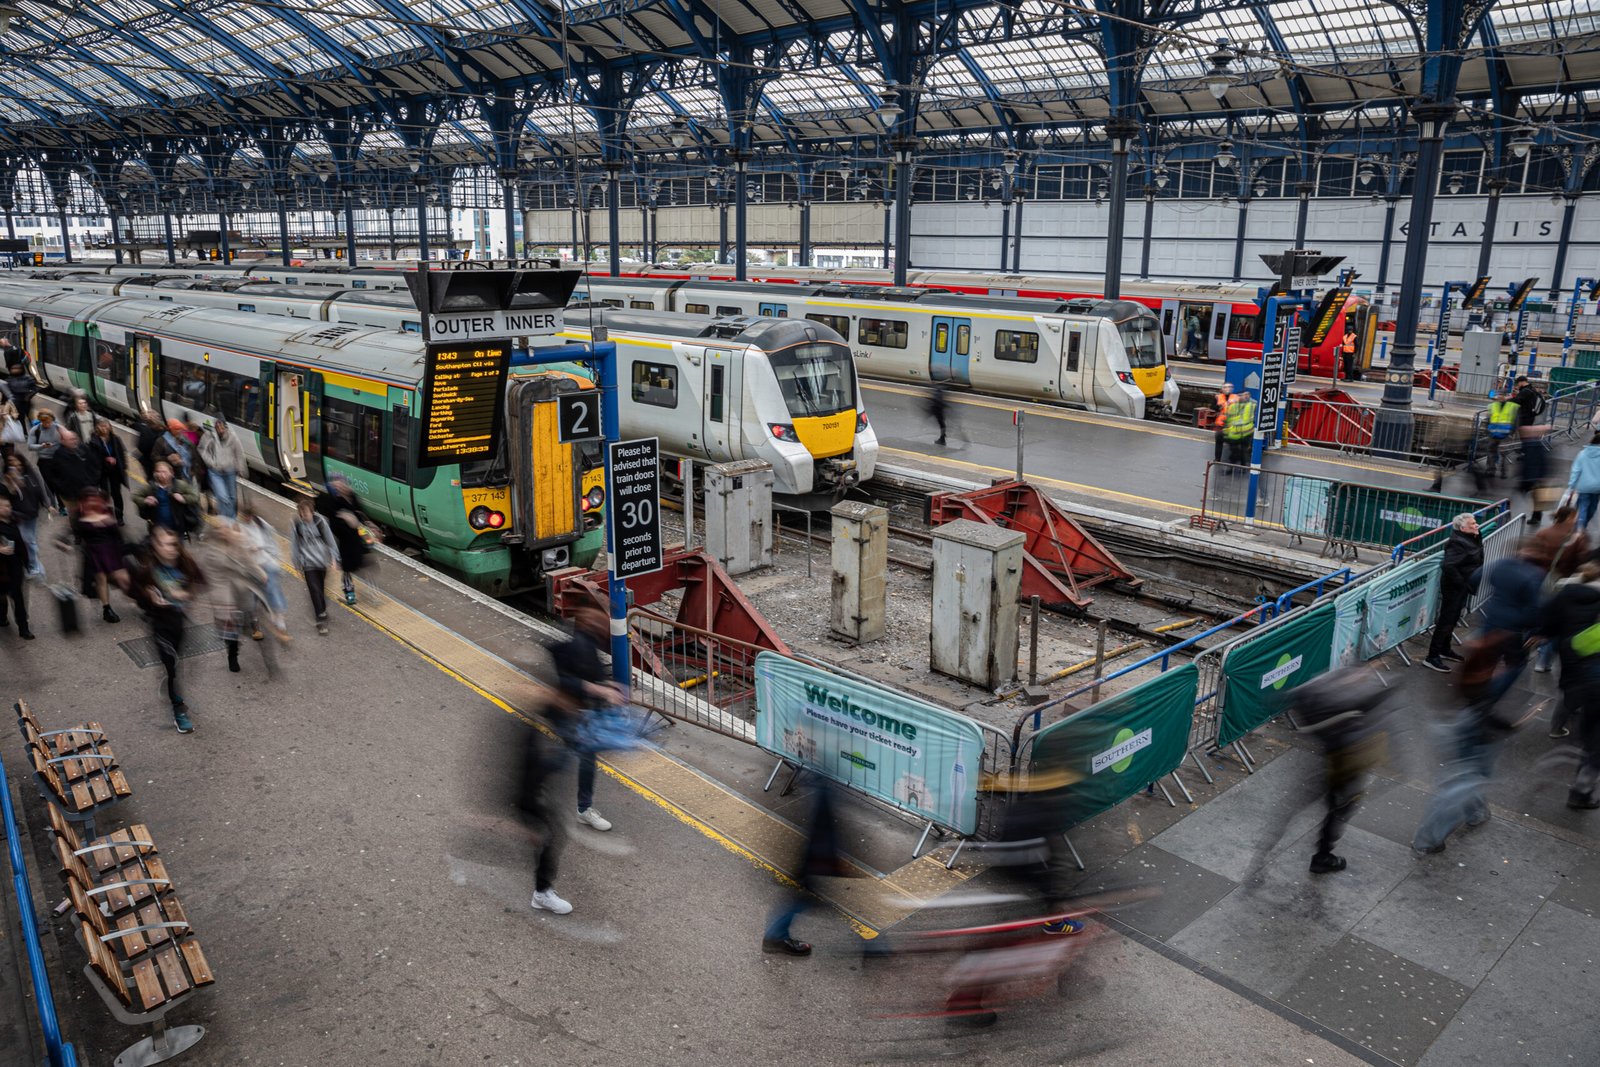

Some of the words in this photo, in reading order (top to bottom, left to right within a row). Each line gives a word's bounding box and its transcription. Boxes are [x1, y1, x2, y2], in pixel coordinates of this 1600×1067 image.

[435, 317, 495, 334] OUTER
[506, 314, 556, 330] INNER
[1274, 327, 1281, 345] 3
[437, 352, 457, 360] 1343
[1288, 352, 1296, 364] 30
[1263, 387, 1277, 403] 30
[571, 401, 589, 434] 2
[427, 443, 467, 452] Southern
[617, 448, 640, 458] Please
[641, 445, 651, 454] be
[613, 458, 640, 472] advised
[642, 457, 657, 467] that
[590, 473, 602, 483] 143
[616, 473, 633, 484] train
[634, 471, 655, 481] doors
[471, 493, 488, 503] 377
[491, 490, 505, 500] 143
[619, 485, 633, 496] will
[633, 483, 651, 493] close
[622, 499, 653, 529] 30
[623, 532, 652, 546] seconds
[625, 547, 643, 560] prior
[643, 545, 652, 554] to
[621, 556, 656, 571] departure
[1263, 660, 1301, 684] SOUTHERN
[804, 680, 917, 741] Welcome
[806, 707, 829, 722] Please
[830, 716, 848, 730] have
[849, 725, 868, 737] your
[869, 732, 892, 747] ticket
[893, 741, 917, 757] ready
[1094, 733, 1151, 768] SOUTHERN
